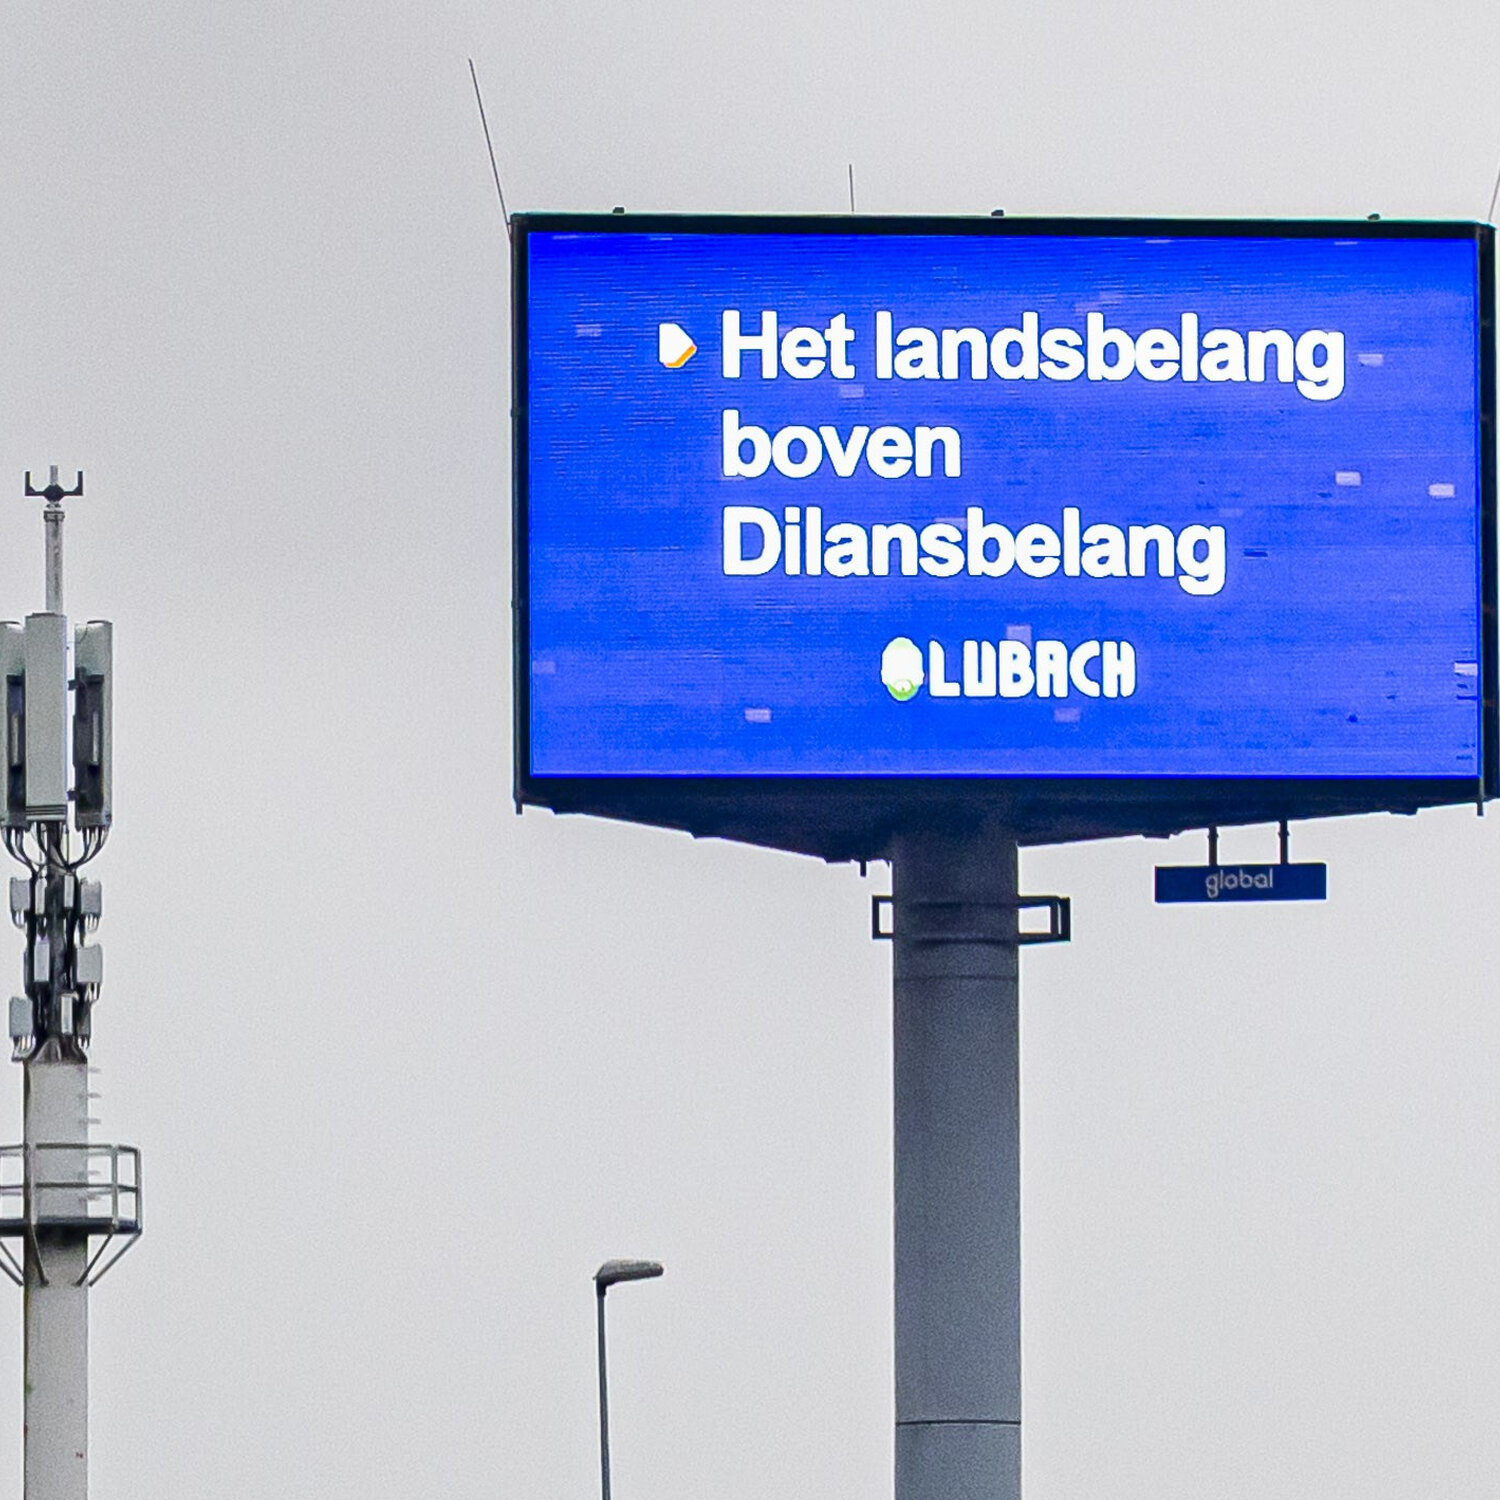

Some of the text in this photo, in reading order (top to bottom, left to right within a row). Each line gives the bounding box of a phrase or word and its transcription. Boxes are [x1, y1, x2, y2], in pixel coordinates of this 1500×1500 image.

[722, 310, 1345, 401] Het landsbelang
[723, 409, 961, 479] boven
[723, 506, 1226, 595] Dilansbelang
[929, 640, 1136, 698] LUBACH
[1205, 868, 1273, 898] global
